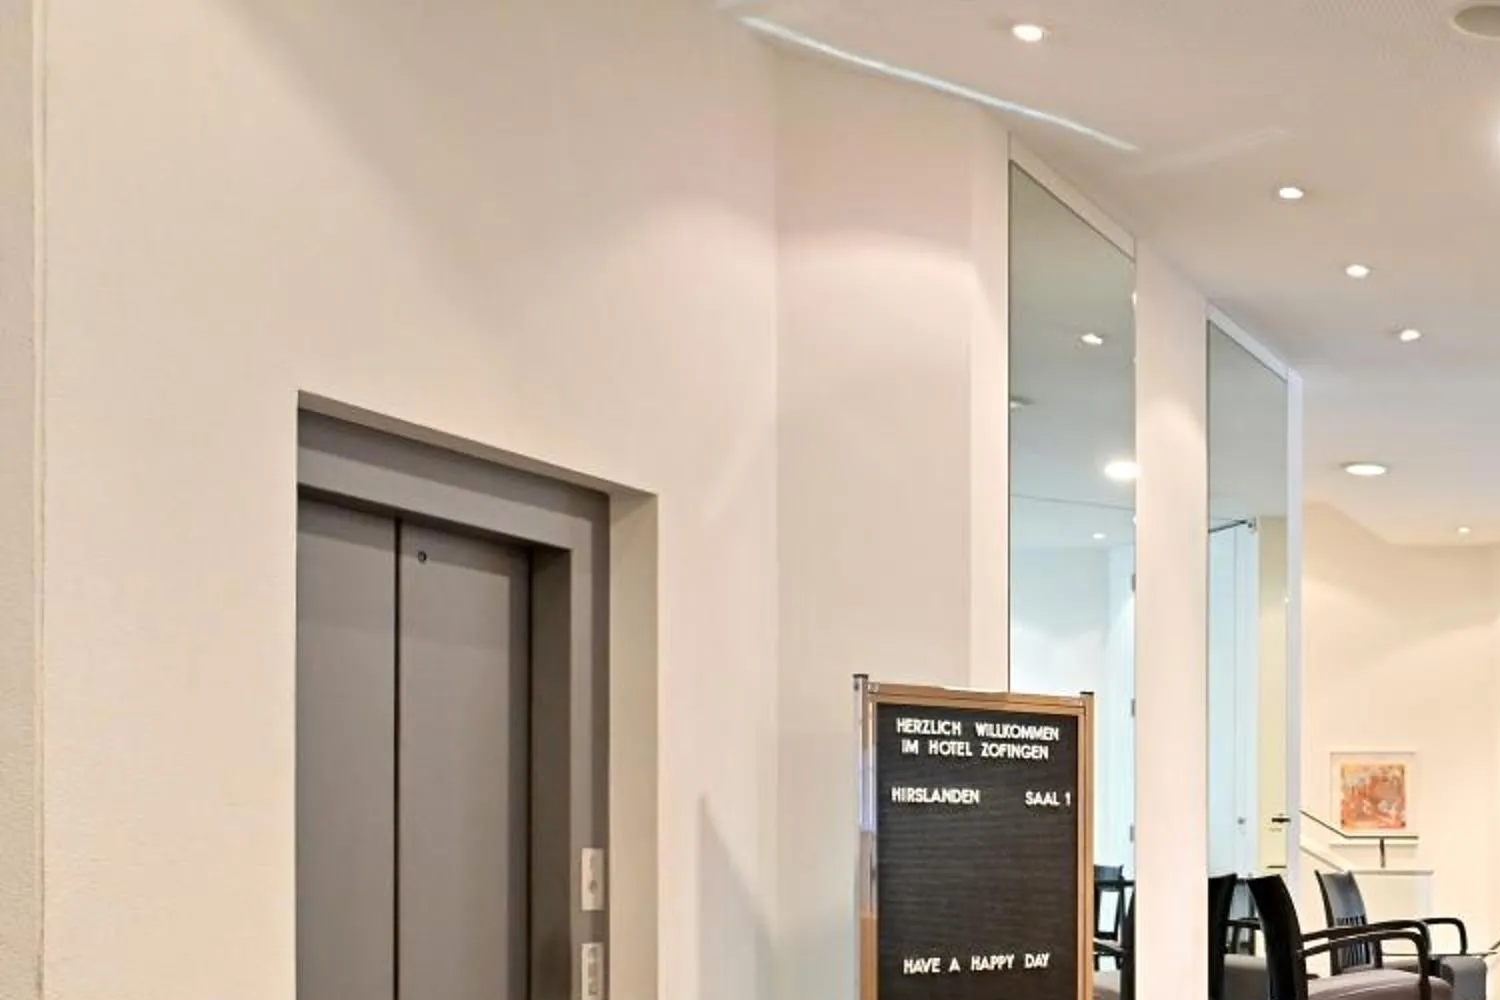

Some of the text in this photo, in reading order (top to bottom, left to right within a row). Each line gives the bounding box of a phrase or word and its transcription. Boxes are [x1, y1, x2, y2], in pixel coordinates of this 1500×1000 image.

[896, 718, 1059, 741] HERZLICH WILLKOMMEN
[901, 739, 1049, 759] IM HOTEL ZOFINGEN
[891, 787, 1072, 806] HIRSLANDEN SAAL 1
[903, 952, 1050, 975] HAVE A HAPPY DAY
